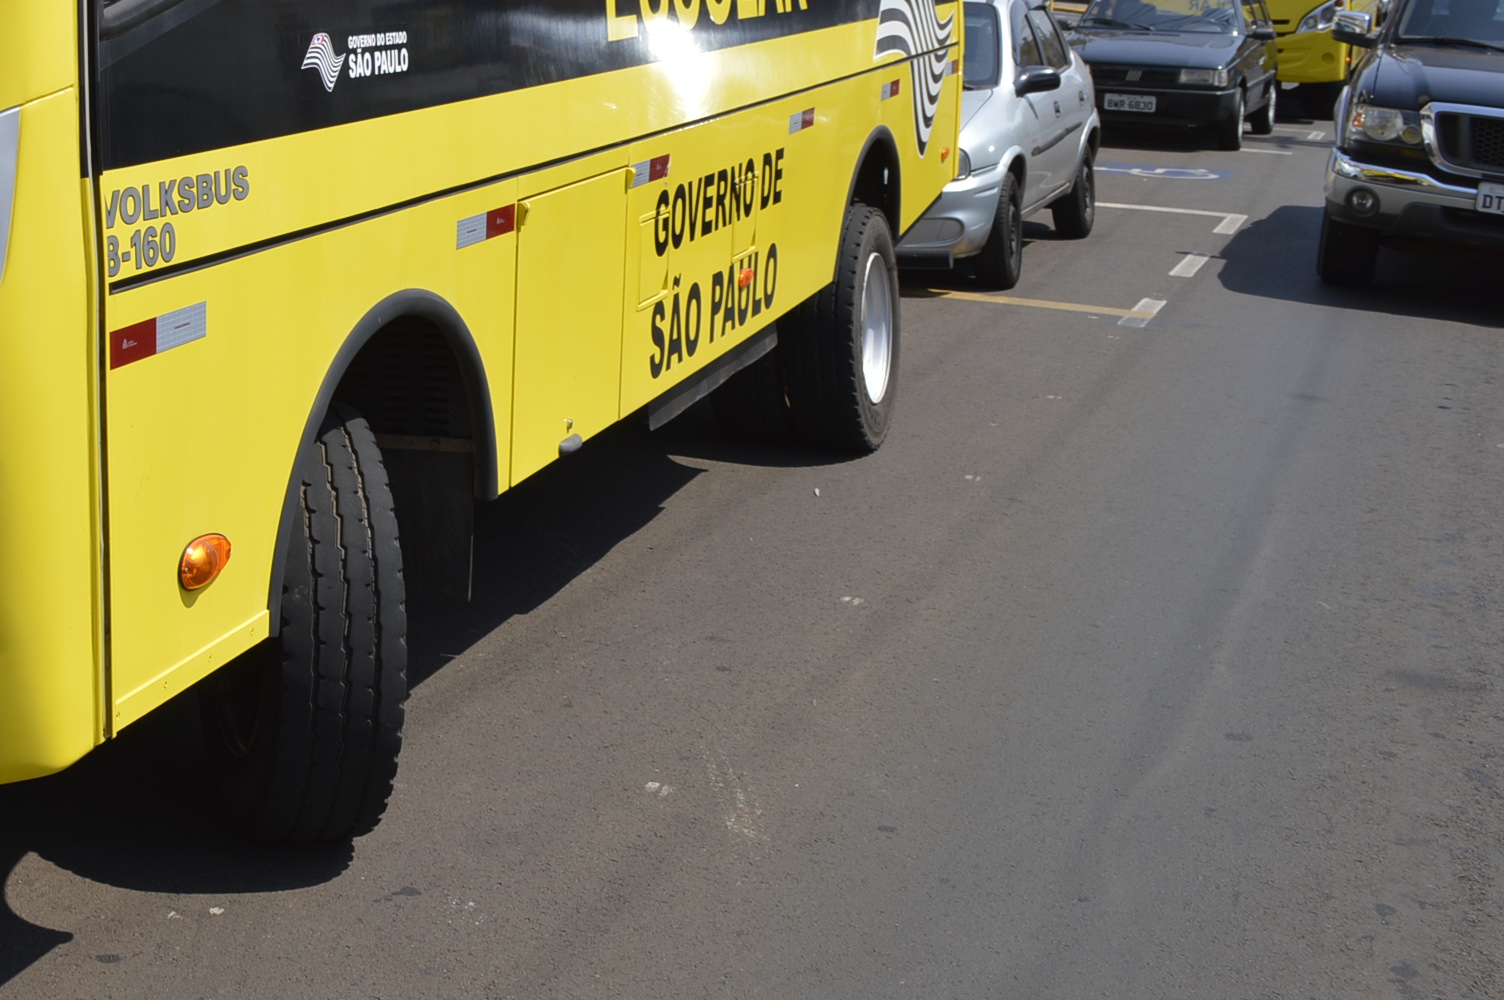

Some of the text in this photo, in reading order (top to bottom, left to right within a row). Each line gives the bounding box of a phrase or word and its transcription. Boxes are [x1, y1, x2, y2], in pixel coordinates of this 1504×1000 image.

[348, 31, 407, 49] GOVERNO DO ESTADO
[349, 47, 409, 78] SÃO PAULO
[104, 165, 251, 229] VOLKSBUS
[654, 147, 785, 257] GOVERNO DE
[649, 242, 778, 380] SÃO PAULO
